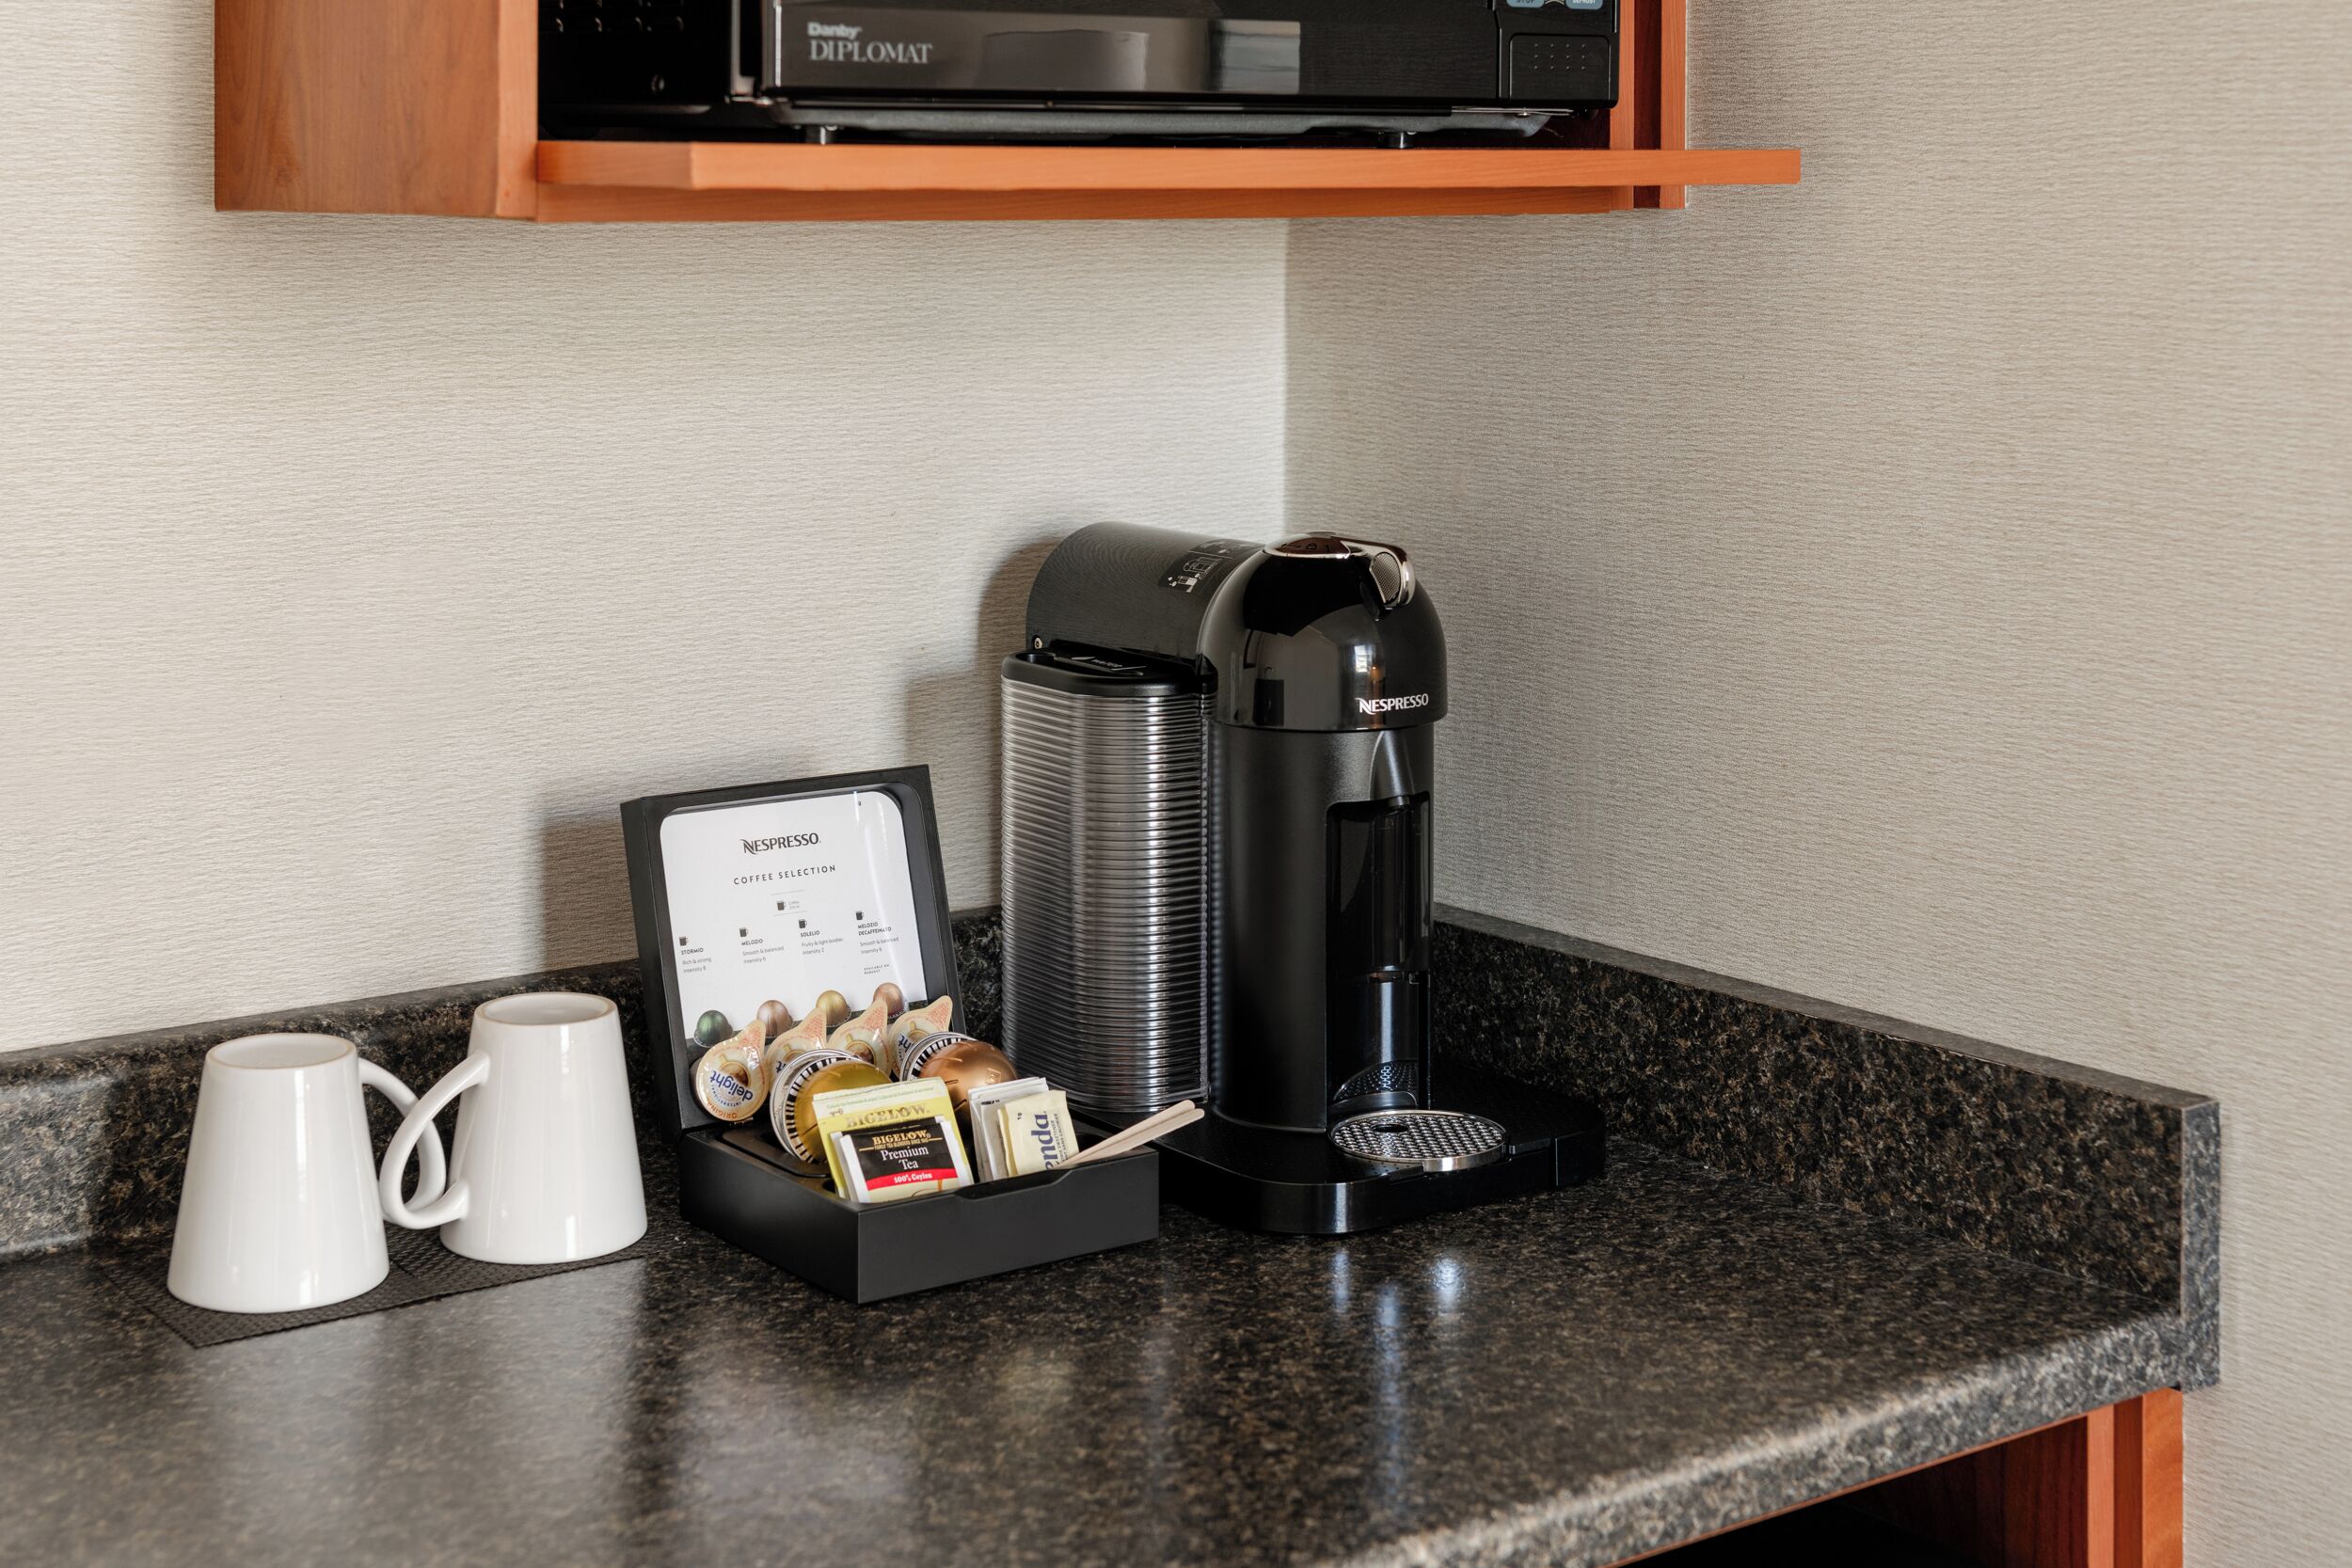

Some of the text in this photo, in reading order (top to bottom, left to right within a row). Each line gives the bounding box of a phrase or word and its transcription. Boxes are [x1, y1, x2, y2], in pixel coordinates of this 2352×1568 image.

[807, 22, 860, 40] Danby
[810, 39, 933, 64] DIPLOMAT
[1355, 693, 1429, 715] NESPRESSO
[740, 832, 819, 855] NESPRESSO
[734, 864, 835, 885] COFFEE SELECTION
[709, 1070, 754, 1101] delight
[846, 1104, 927, 1128] BIGELOW
[881, 1146, 930, 1161] Premium
[898, 1158, 919, 1170] Tea
[894, 1172, 932, 1183] 100% Ceylon
